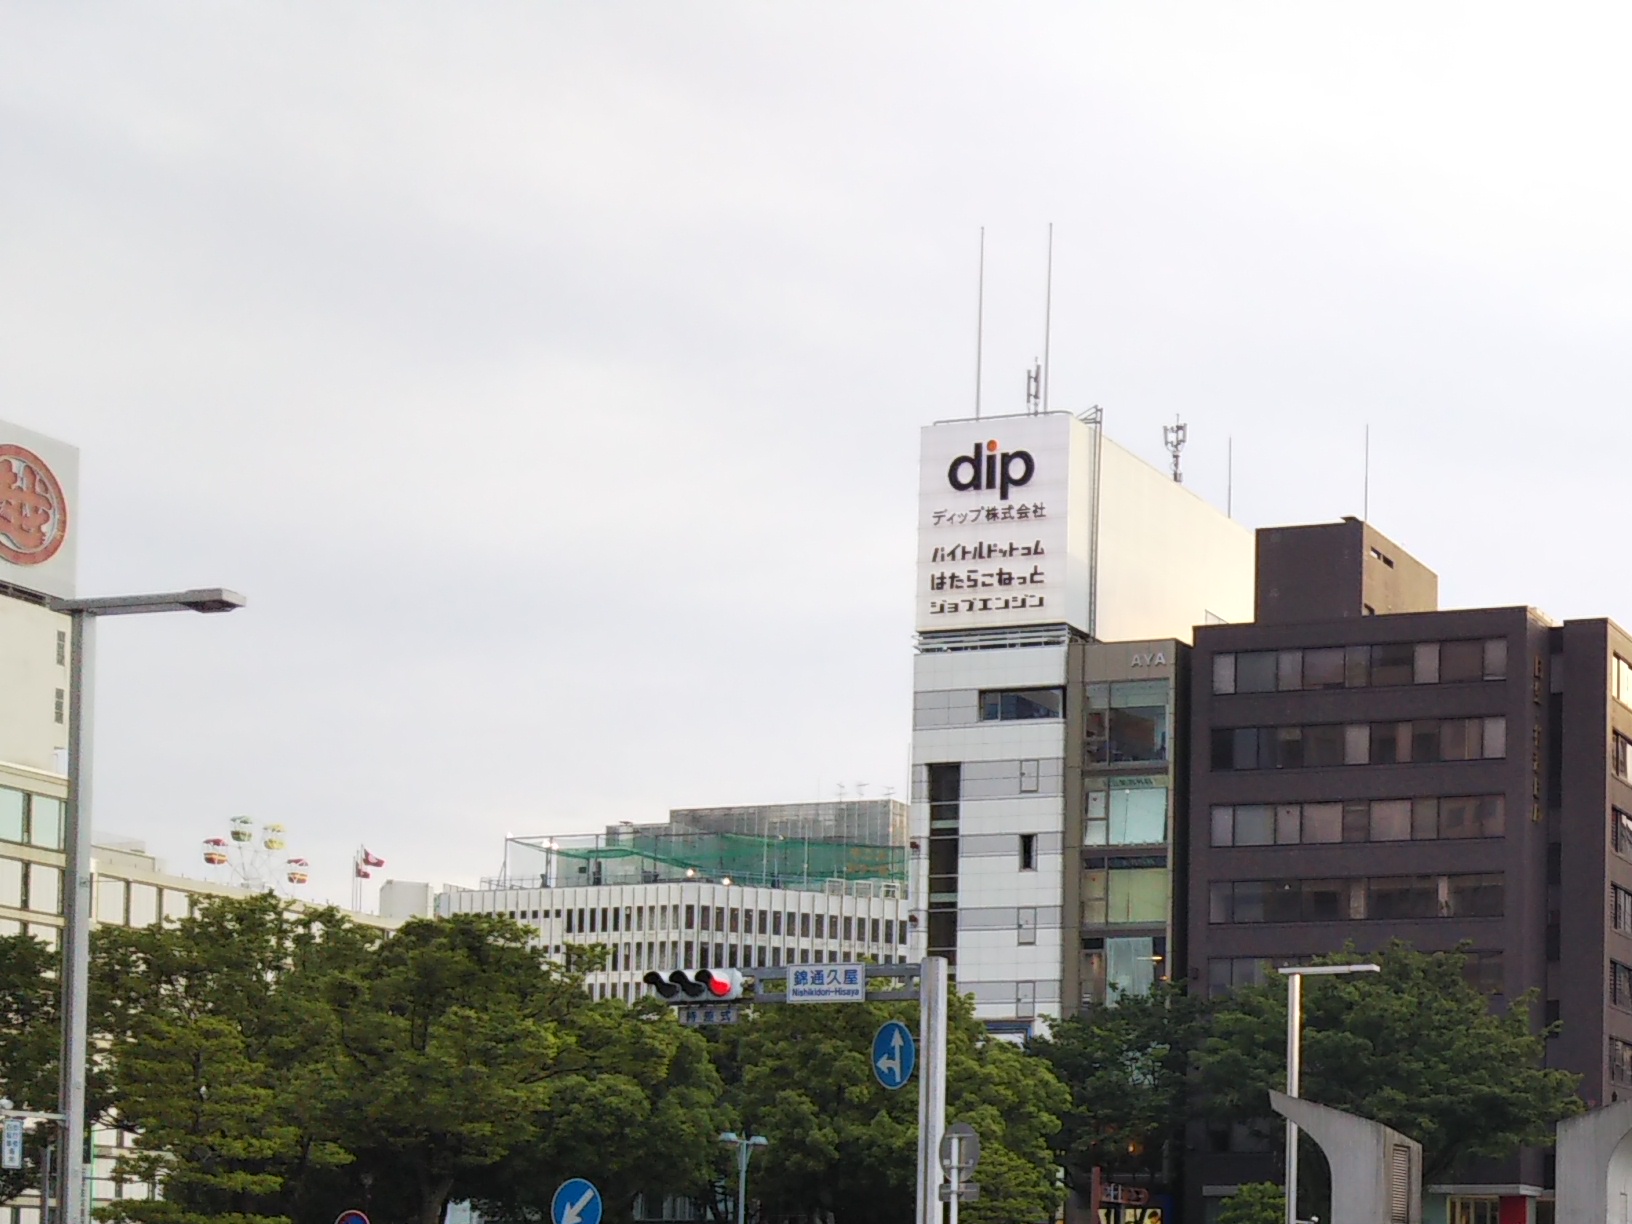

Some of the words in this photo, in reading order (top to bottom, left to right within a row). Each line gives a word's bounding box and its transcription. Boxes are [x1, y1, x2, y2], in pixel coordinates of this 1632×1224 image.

[947, 439, 1035, 500] dip
[932, 502, 1047, 526] ディップ株式会社
[931, 540, 1045, 563] バイトルドットコム
[930, 565, 1045, 591] はたらこねっと
[929, 594, 1045, 615] ジョブエンジン
[1131, 652, 1167, 668] AYA
[793, 969, 859, 986] 錦通久屋
